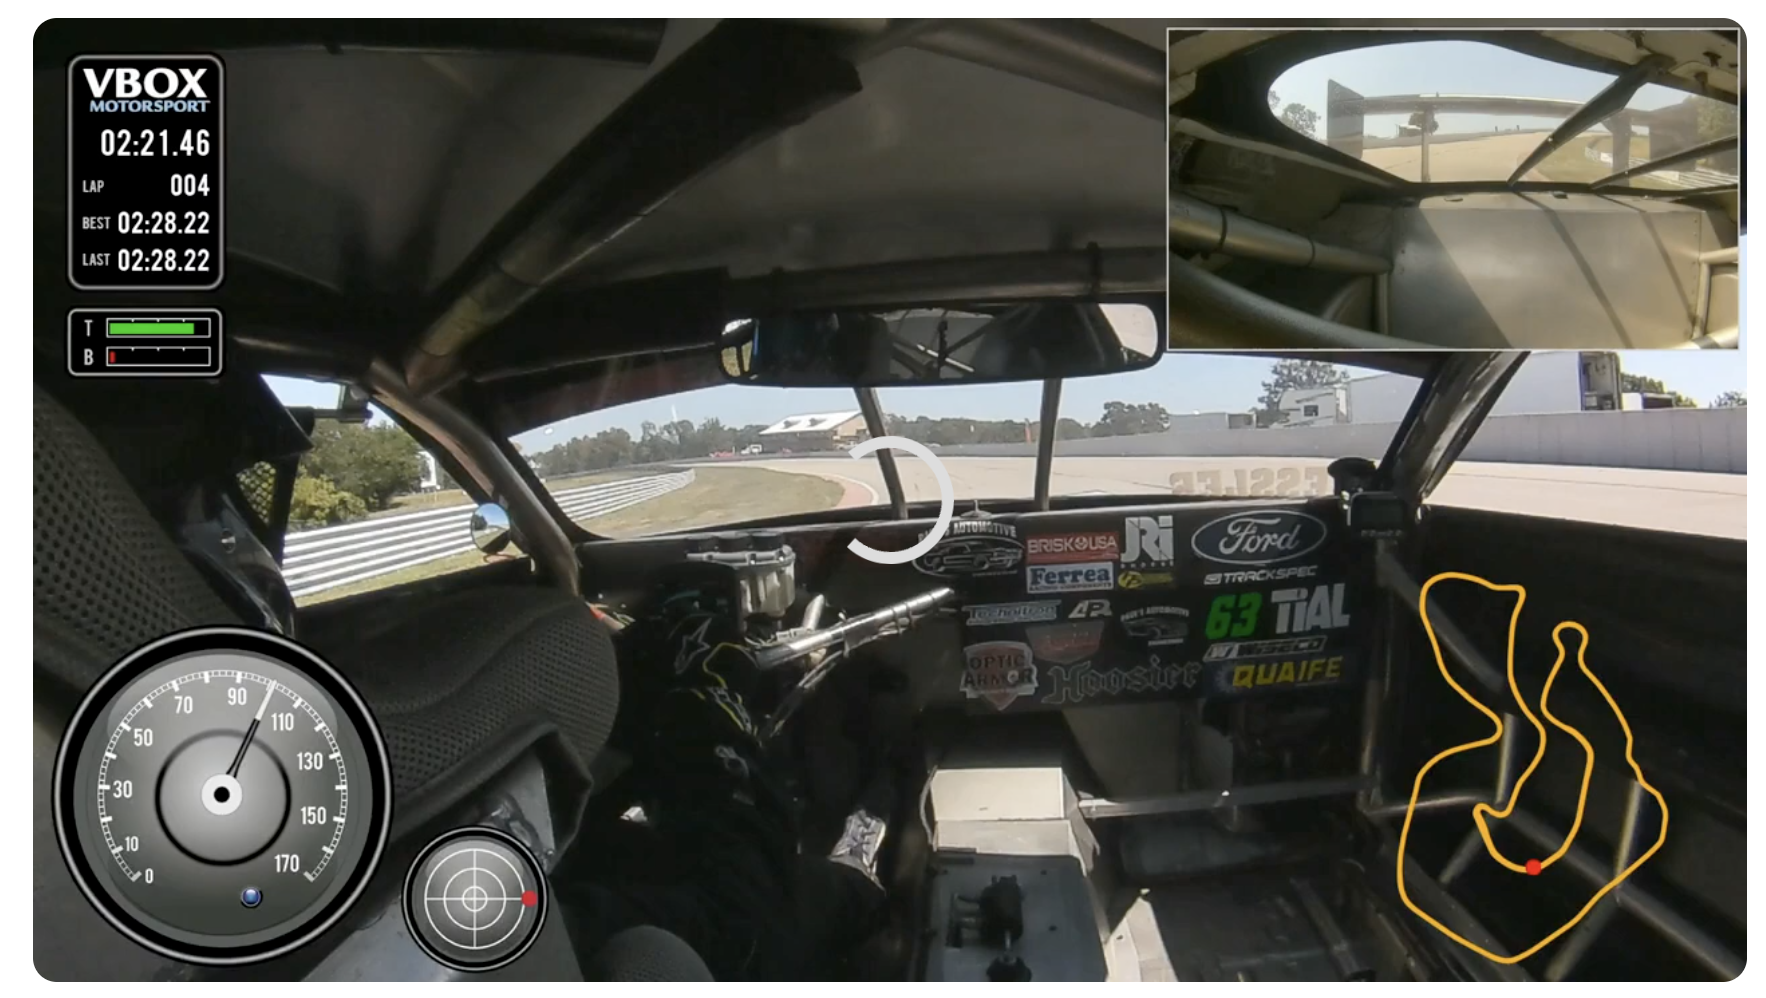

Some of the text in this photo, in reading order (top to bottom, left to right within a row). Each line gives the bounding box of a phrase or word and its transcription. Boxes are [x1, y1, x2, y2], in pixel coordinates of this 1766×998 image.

[953, 521, 1017, 538] AUTOMOTIVE
[1219, 518, 1302, 555] Ford
[1030, 567, 1110, 586] Ferrea
[1224, 565, 1318, 584] TRACKSPEC
[1205, 592, 1263, 640] 63
[970, 654, 1026, 671] OPTIC
[1232, 656, 1344, 688] QUAIFE
[1041, 654, 1201, 704] Hoosier
